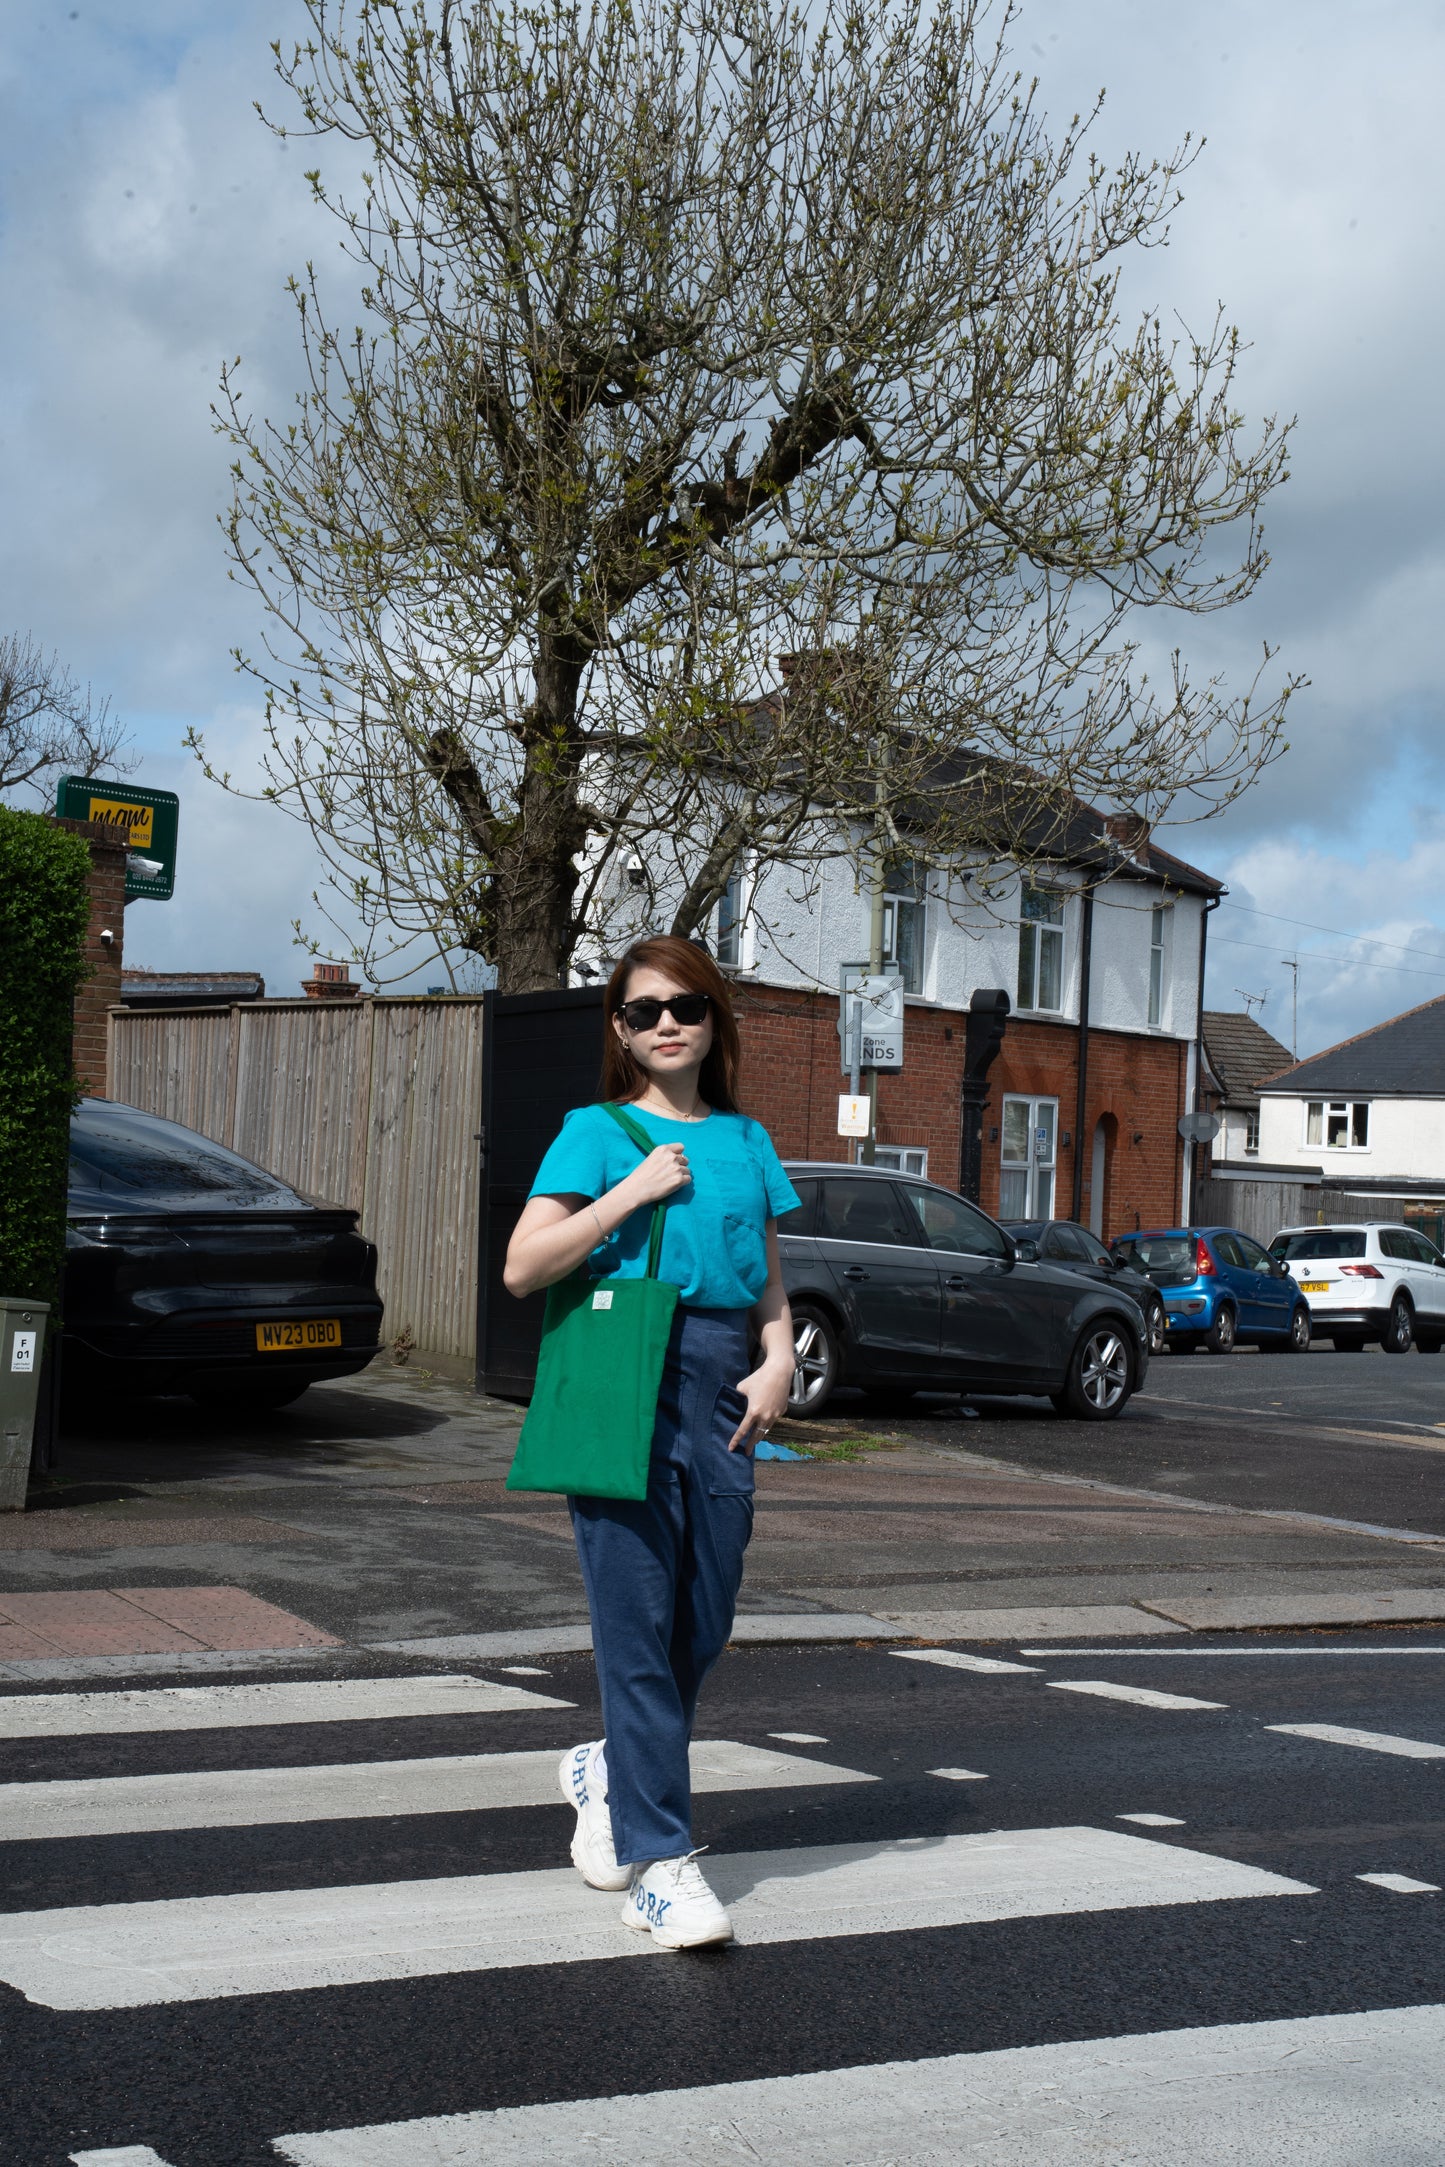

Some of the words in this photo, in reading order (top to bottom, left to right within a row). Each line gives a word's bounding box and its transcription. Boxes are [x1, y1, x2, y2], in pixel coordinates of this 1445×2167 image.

[863, 1037, 886, 1046] Zone
[860, 1047, 895, 1060] NDS
[263, 1325, 303, 1347] MV23
[21, 1339, 28, 1347] F
[17, 1350, 30, 1359] 01
